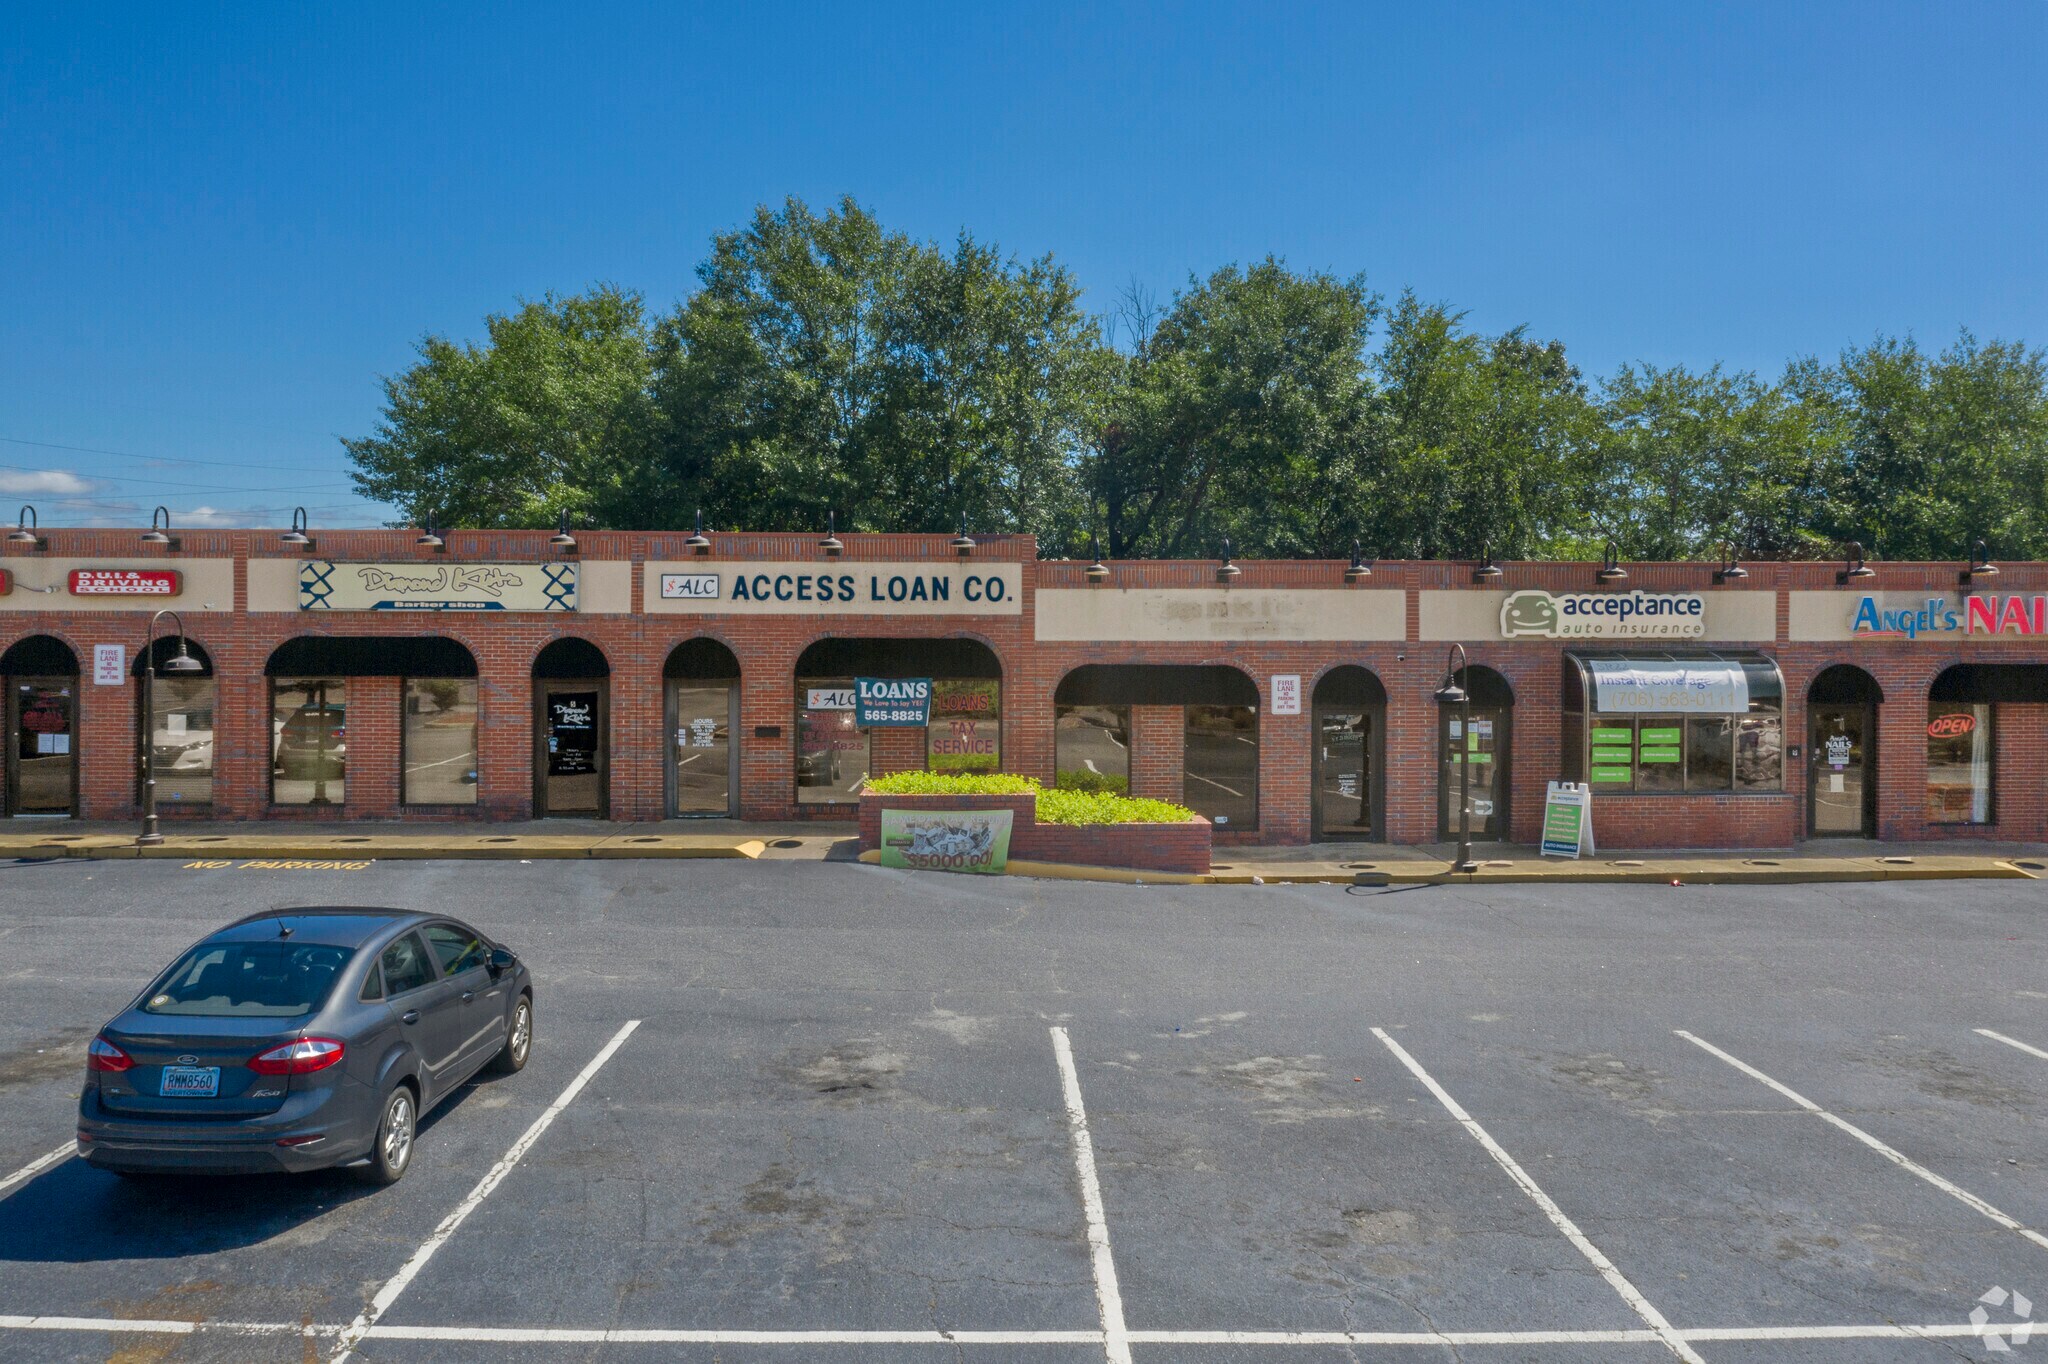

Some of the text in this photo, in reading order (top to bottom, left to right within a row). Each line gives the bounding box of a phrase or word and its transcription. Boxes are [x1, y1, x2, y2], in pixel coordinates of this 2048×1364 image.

[678, 579, 715, 595] ALC
[731, 575, 1013, 602] ACCESS LOAN CO.
[448, 601, 486, 609] shop
[1563, 595, 1702, 622] acceptance
[1965, 596, 2048, 635] NAI
[1562, 623, 1701, 634] auto insurance
[1601, 675, 1646, 686] Instant
[860, 682, 928, 699] LOANS
[940, 694, 989, 711] LOANS
[1612, 691, 1654, 709] (706)
[864, 710, 923, 721] 565-8825
[950, 721, 976, 736] TAX
[1931, 719, 1971, 733] OPEN
[933, 739, 994, 755] SERVICE
[1826, 741, 1852, 749] NAILS
[884, 815, 915, 826] SAME
[917, 814, 941, 824] DAY
[945, 814, 966, 822] TAX
[182, 861, 371, 870] NO PARKING
[167, 1075, 213, 1089] RMM8560
